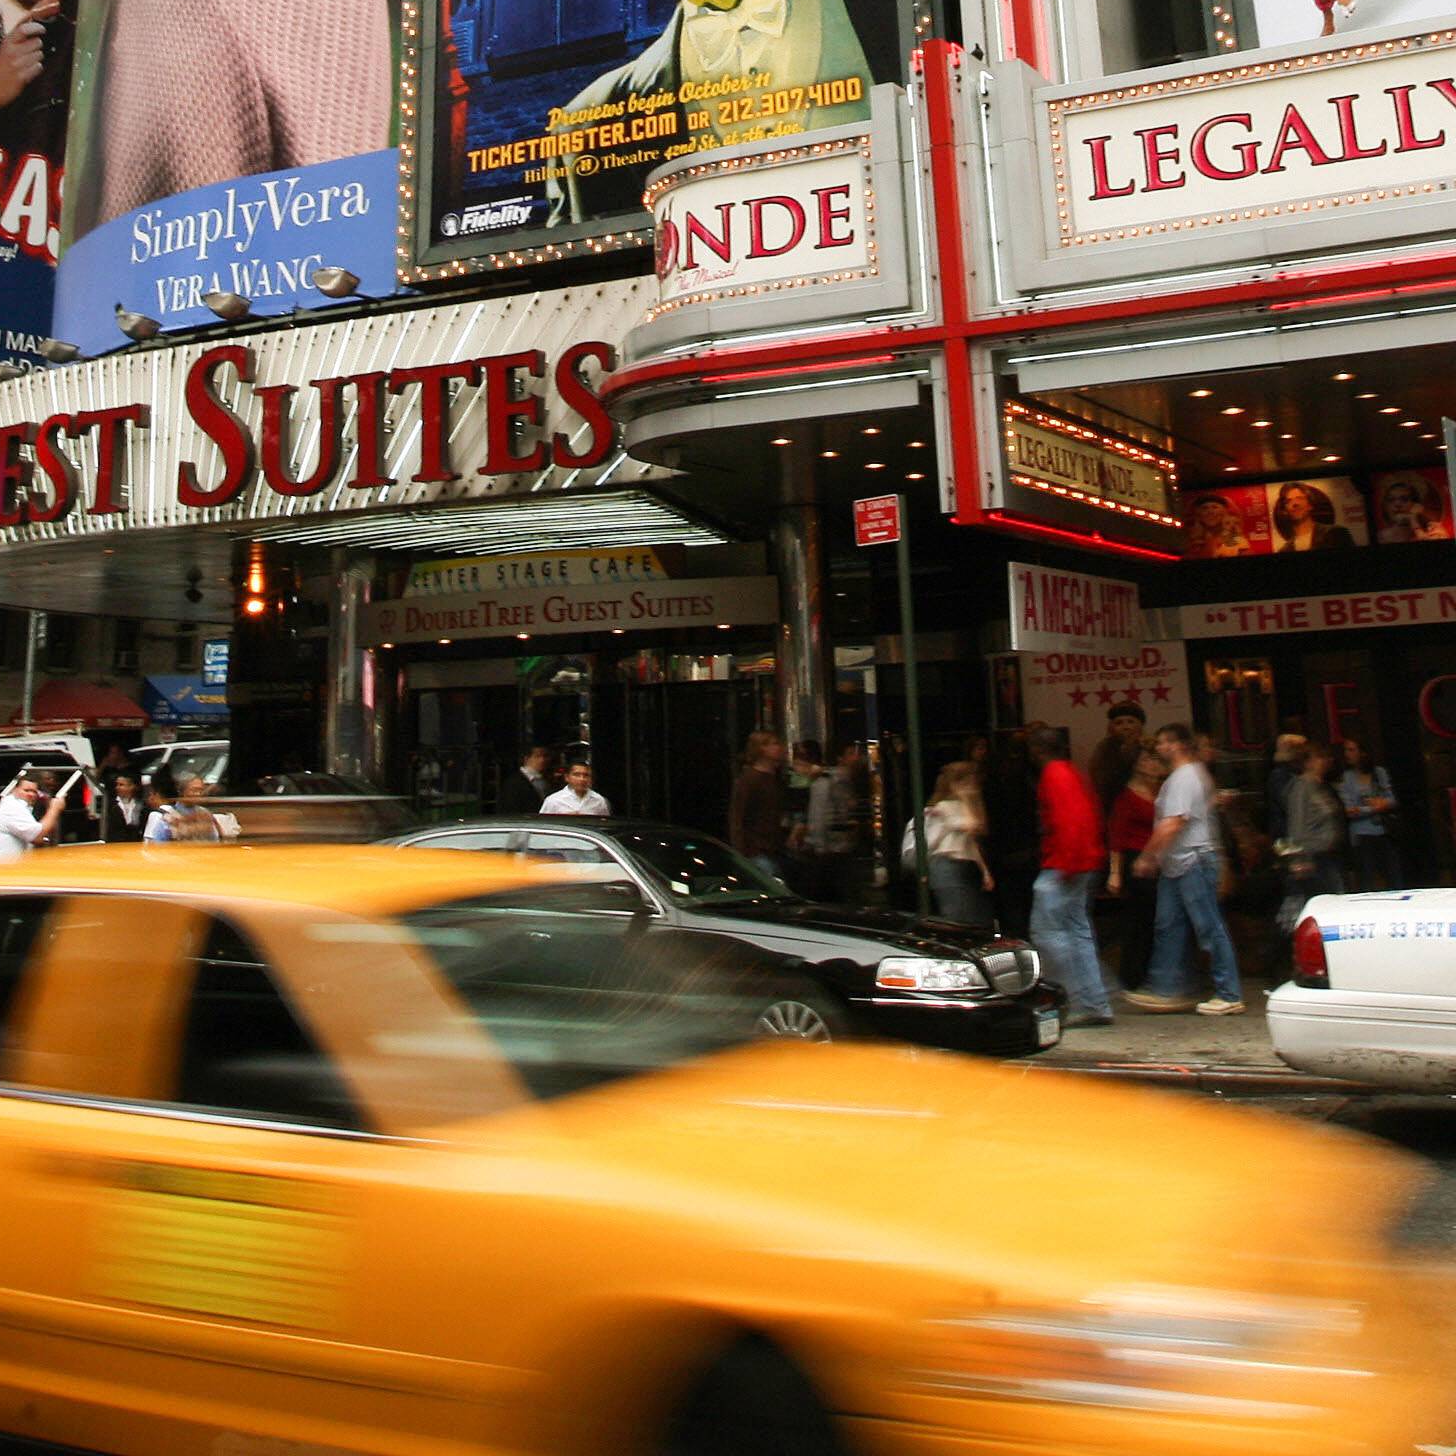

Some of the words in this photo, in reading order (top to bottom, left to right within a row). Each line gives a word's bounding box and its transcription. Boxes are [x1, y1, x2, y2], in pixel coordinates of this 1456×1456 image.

[467, 110, 678, 173] TICKETMASTER.COM
[718, 77, 864, 125] 212.307.4100
[130, 176, 371, 266] SimplyVera
[461, 203, 534, 230] Fidelity
[155, 270, 222, 315] VERA
[178, 340, 620, 508] SUITES
[408, 563, 482, 590] CENTER
[495, 557, 570, 583] STAGE
[589, 552, 655, 577] CAFE
[543, 594, 625, 628] GUEST
[629, 590, 715, 619] SUITES
[1322, 592, 1425, 627] BEST
